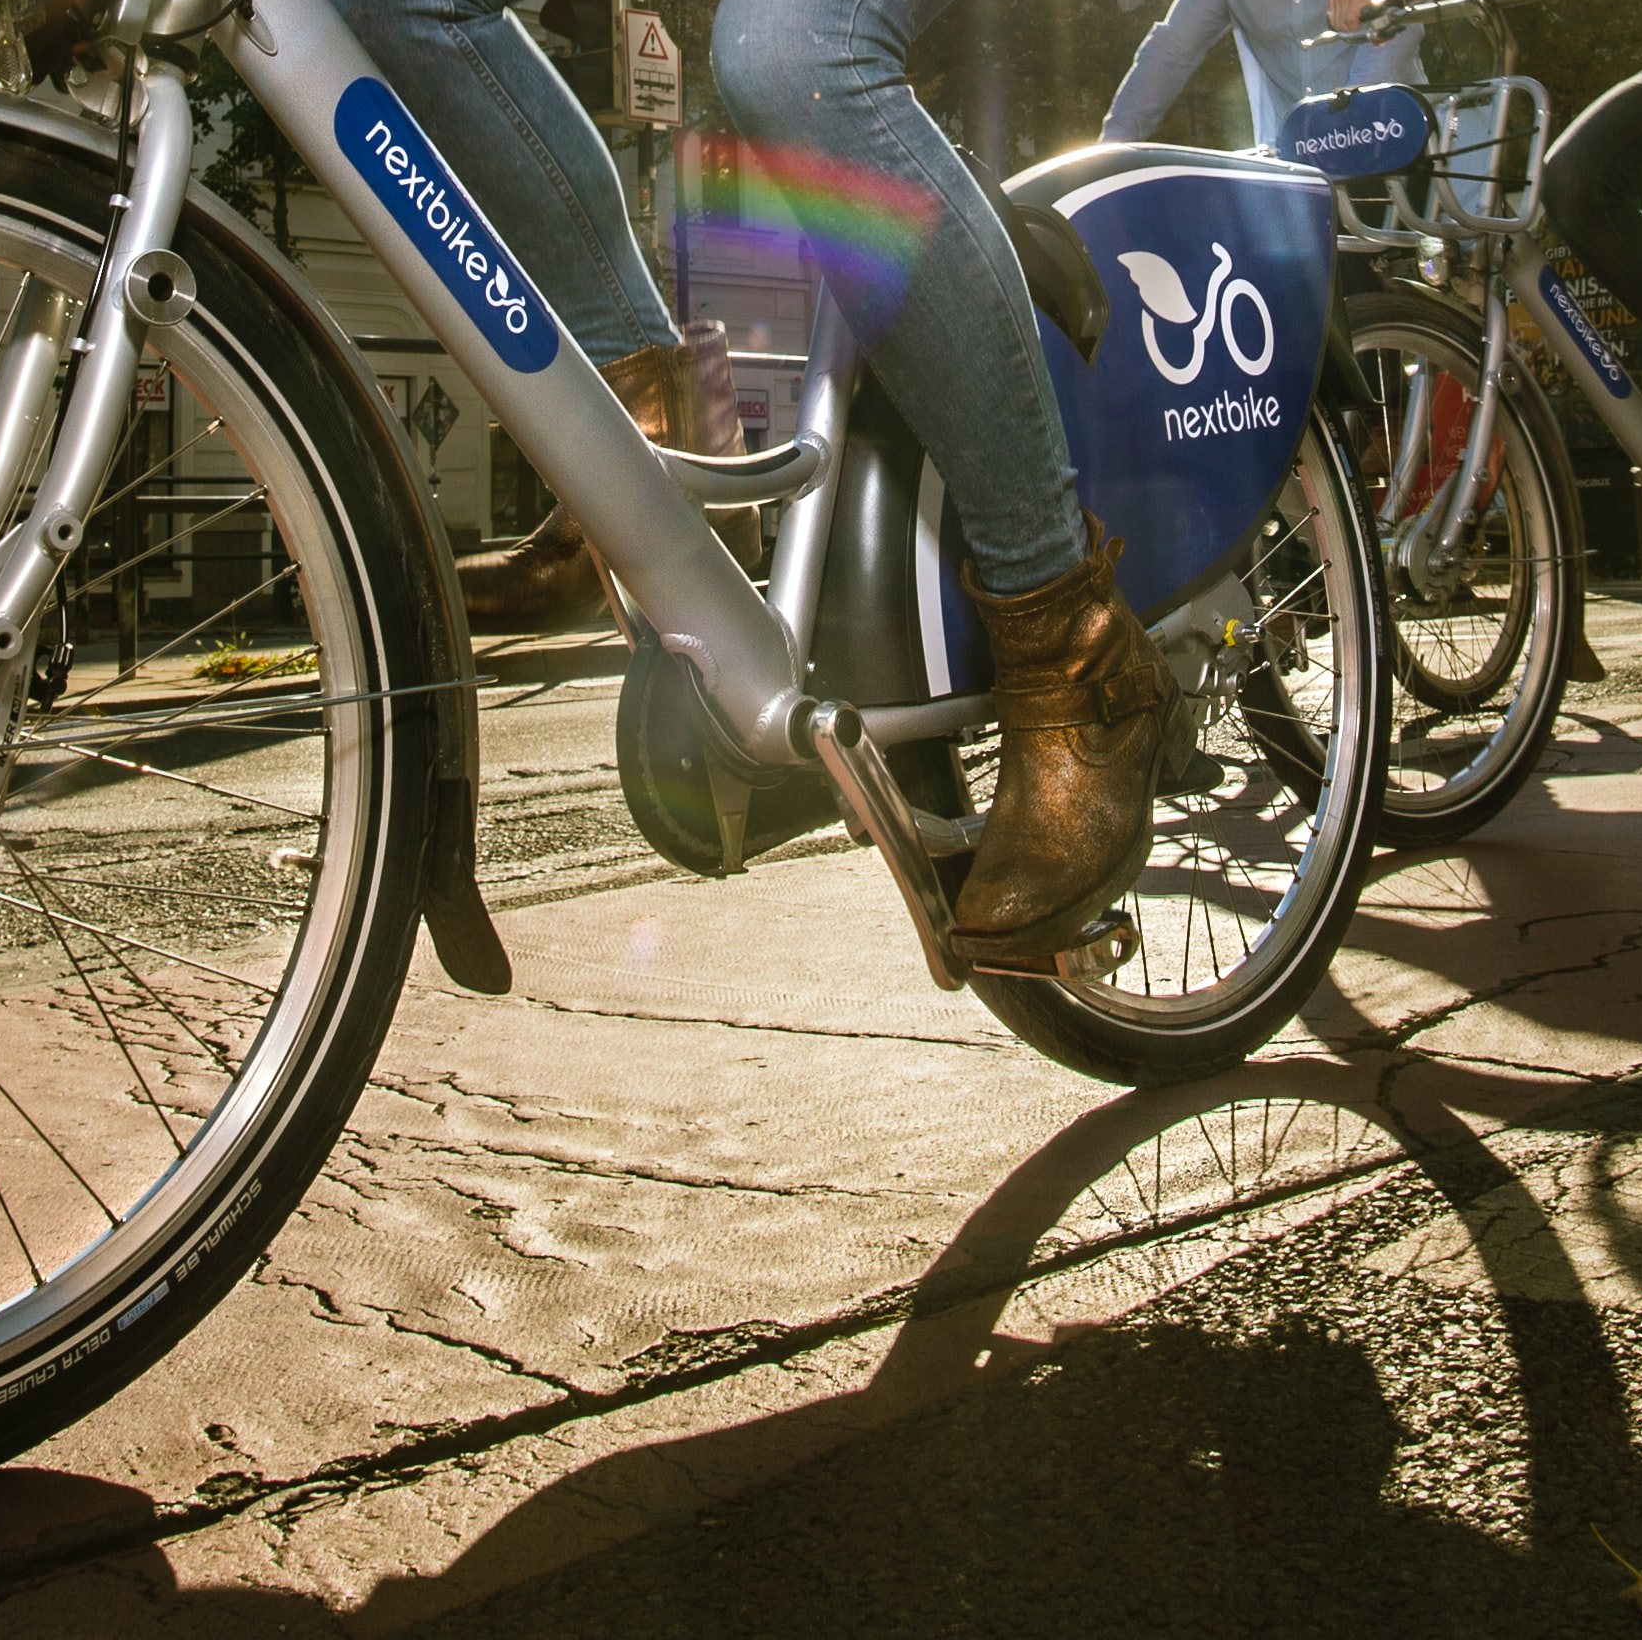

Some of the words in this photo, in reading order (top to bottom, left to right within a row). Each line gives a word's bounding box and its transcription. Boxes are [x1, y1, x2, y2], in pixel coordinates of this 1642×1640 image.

[1295, 125, 1372, 155] nextbike
[365, 120, 488, 281] nextbike
[1549, 284, 1602, 356] nextbike
[1164, 386, 1281, 442] nextbike
[175, 1178, 263, 1283] SCHWALBE
[62, 1327, 112, 1371] DELTA
